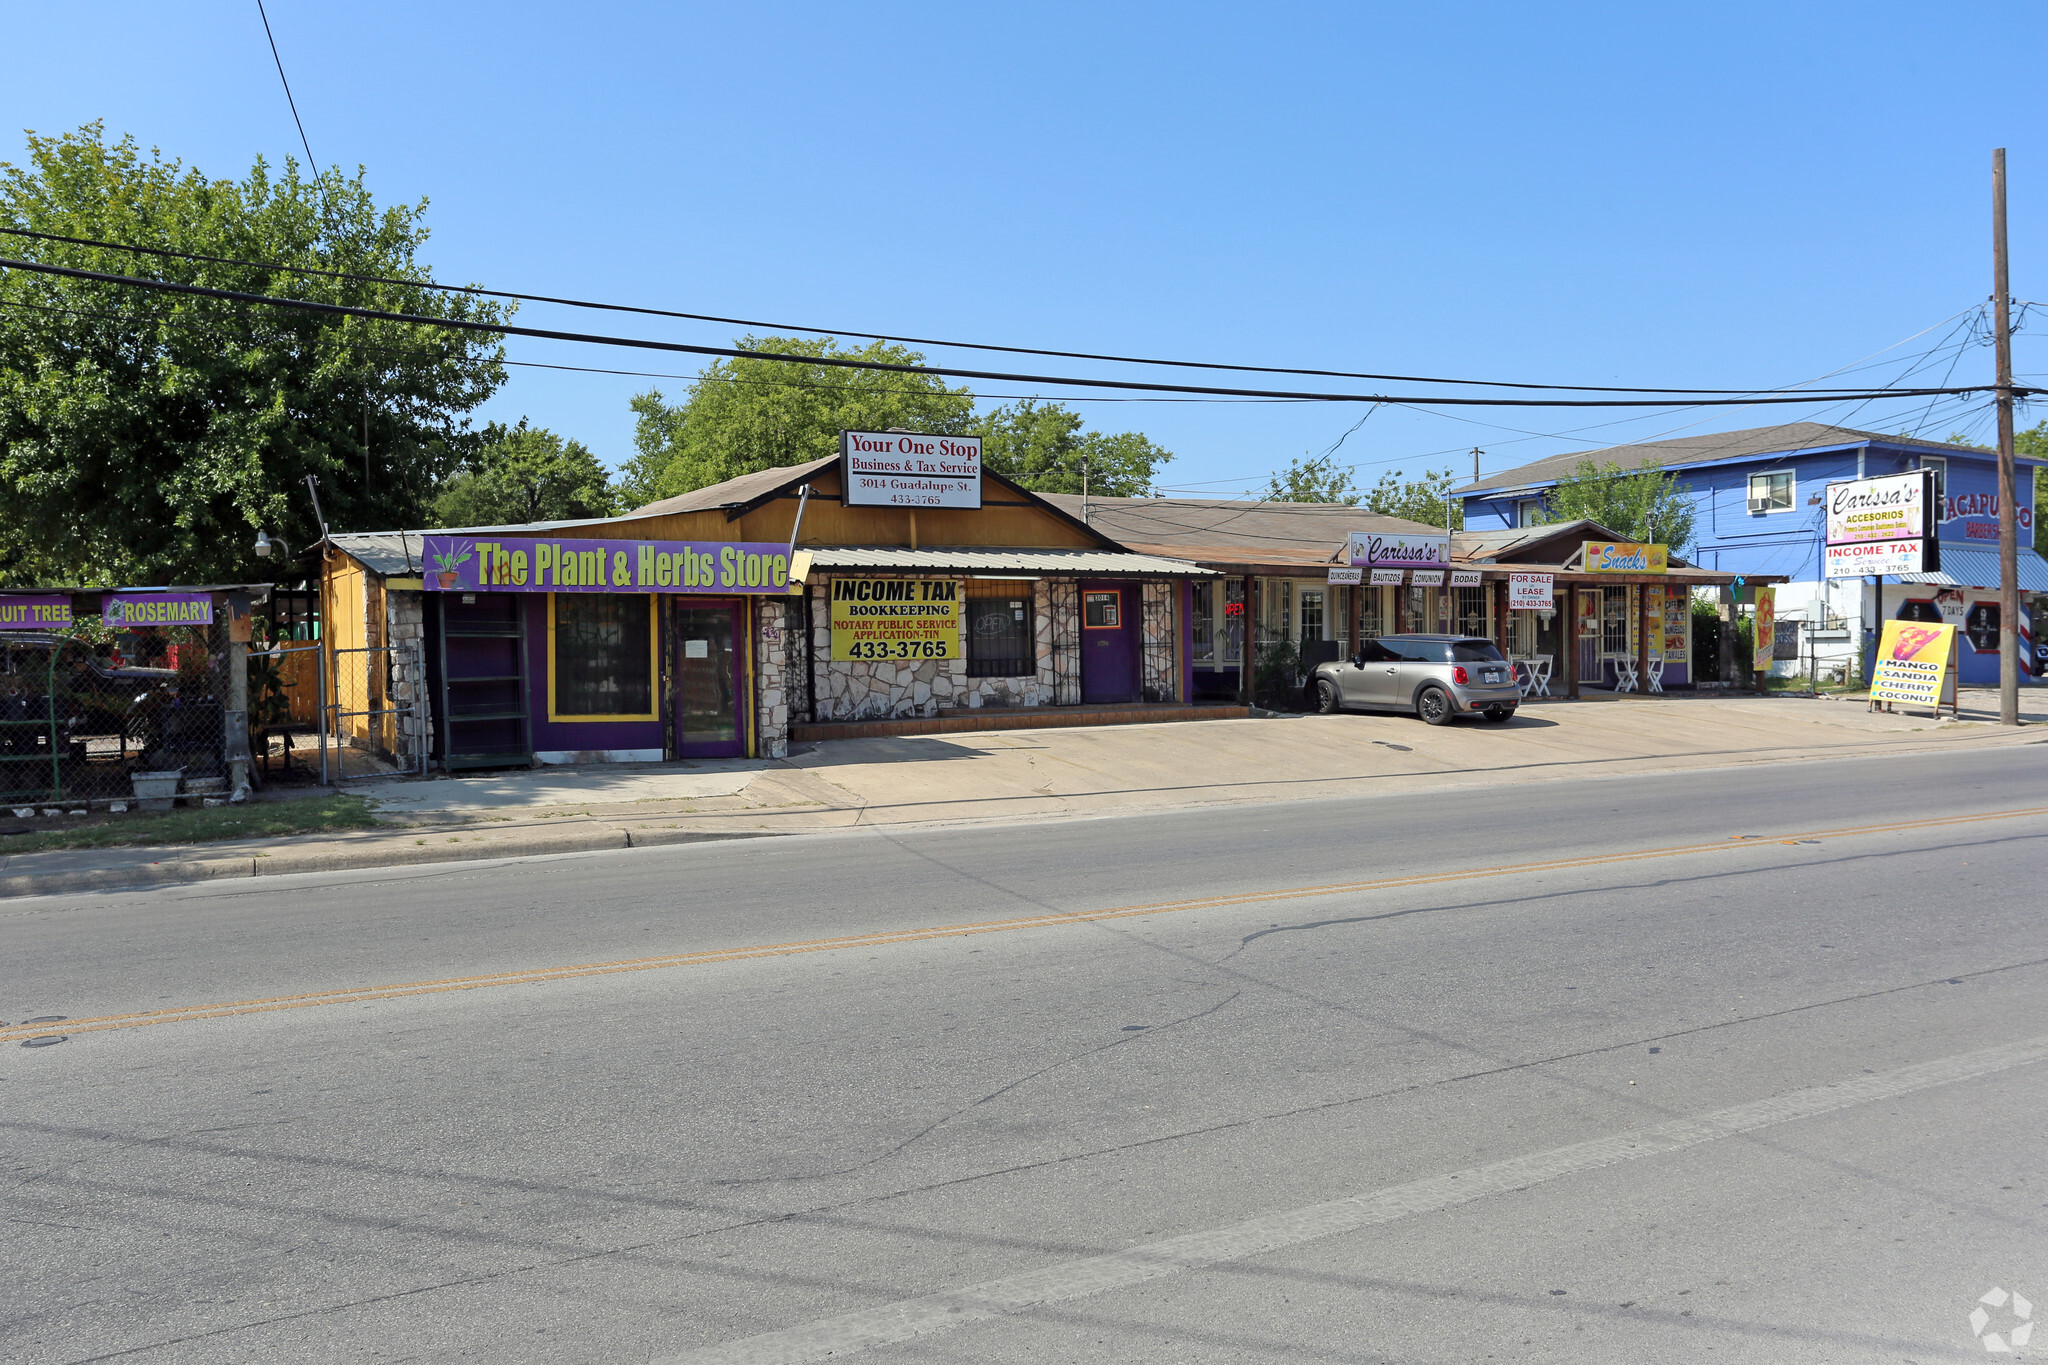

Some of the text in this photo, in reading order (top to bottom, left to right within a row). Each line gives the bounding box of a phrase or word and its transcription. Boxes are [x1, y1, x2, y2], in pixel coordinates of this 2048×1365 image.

[851, 435, 977, 460] Your One Stop
[852, 458, 977, 474] Business & Tax Service
[860, 478, 971, 494] 3014 Guadalupe St.
[891, 494, 941, 505] 433-3765
[1833, 483, 1913, 515] Carissa's
[1846, 510, 1904, 524] ACCESORIOS
[1368, 537, 1433, 563] Carissa's
[1829, 543, 1918, 557] INCOME TAX
[1601, 546, 1647, 570] Snacks
[475, 542, 787, 588] The Plant & Herbs Store
[1885, 564, 1909, 572] 3765
[1373, 572, 1401, 582] BAUTIZOS
[1414, 574, 1442, 583] COMUNION
[1454, 575, 1478, 583] BODAS
[1511, 575, 1552, 584] FOR SALE
[833, 580, 957, 601] INCOME TAX
[0, 604, 71, 623] UIT TREE
[125, 601, 210, 623] ROSEMARY
[849, 605, 950, 616] BOOKKEEPING
[1943, 606, 1964, 616] 7 DAYS
[833, 619, 957, 630] NOTARY PUBLIC SERVICE
[853, 630, 940, 640] APPLICATION-TIN
[849, 640, 947, 659] 433-3765
[1886, 660, 1938, 671] MANGO
[1883, 670, 1937, 682] SANDIA
[1881, 681, 1934, 692] CHERRY
[1879, 691, 1935, 703] COCONUT
